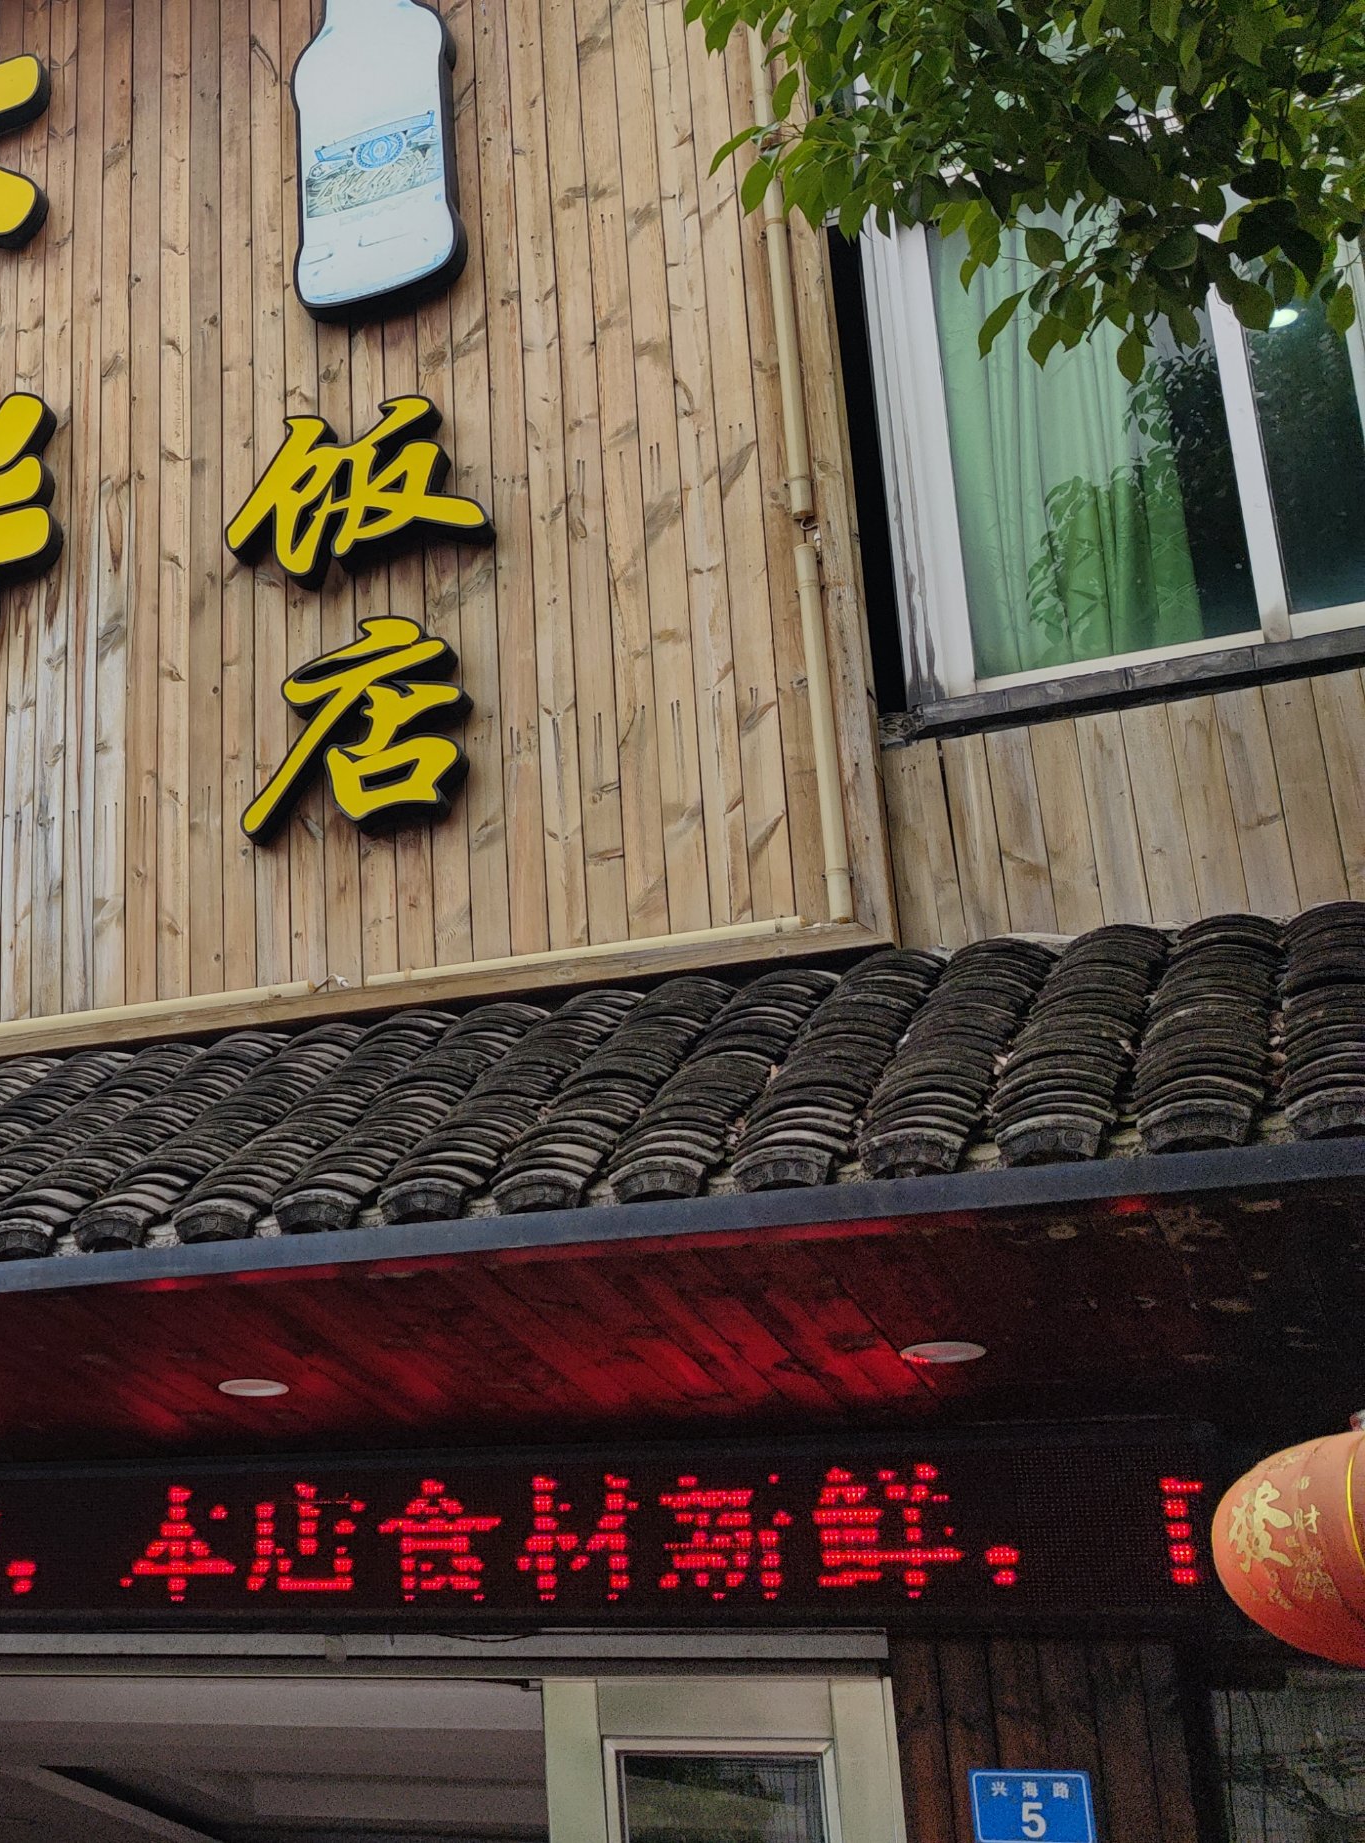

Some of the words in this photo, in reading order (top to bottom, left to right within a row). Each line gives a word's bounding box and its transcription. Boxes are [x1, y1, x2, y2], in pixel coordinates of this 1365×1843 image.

[225, 395, 494, 842] 饭店
[991, 1781, 1070, 1800] 兴海路
[1021, 1802, 1047, 1838] 5
